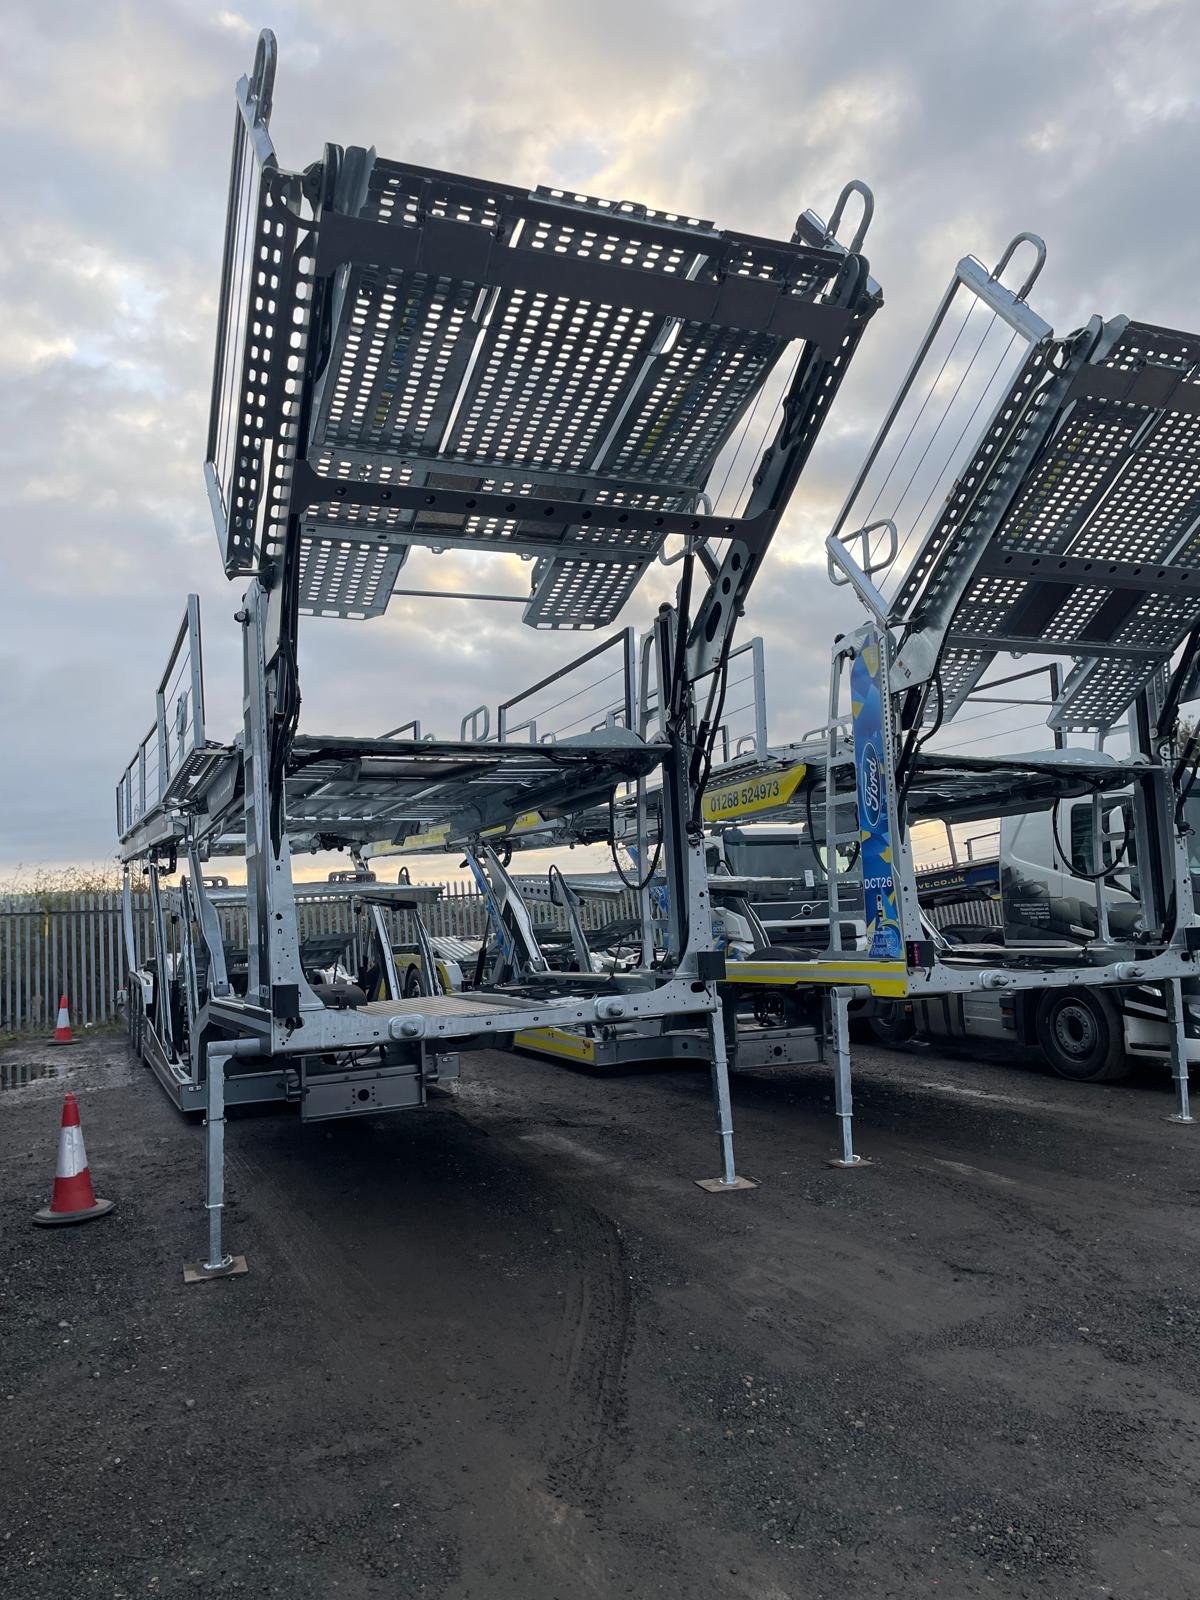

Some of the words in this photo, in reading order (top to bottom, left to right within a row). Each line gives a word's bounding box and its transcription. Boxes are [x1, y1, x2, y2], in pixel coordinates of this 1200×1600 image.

[711, 792, 739, 812] 01268
[741, 781, 779, 805] 524973
[864, 757, 879, 812] Ford
[864, 877, 893, 889] DCT26
